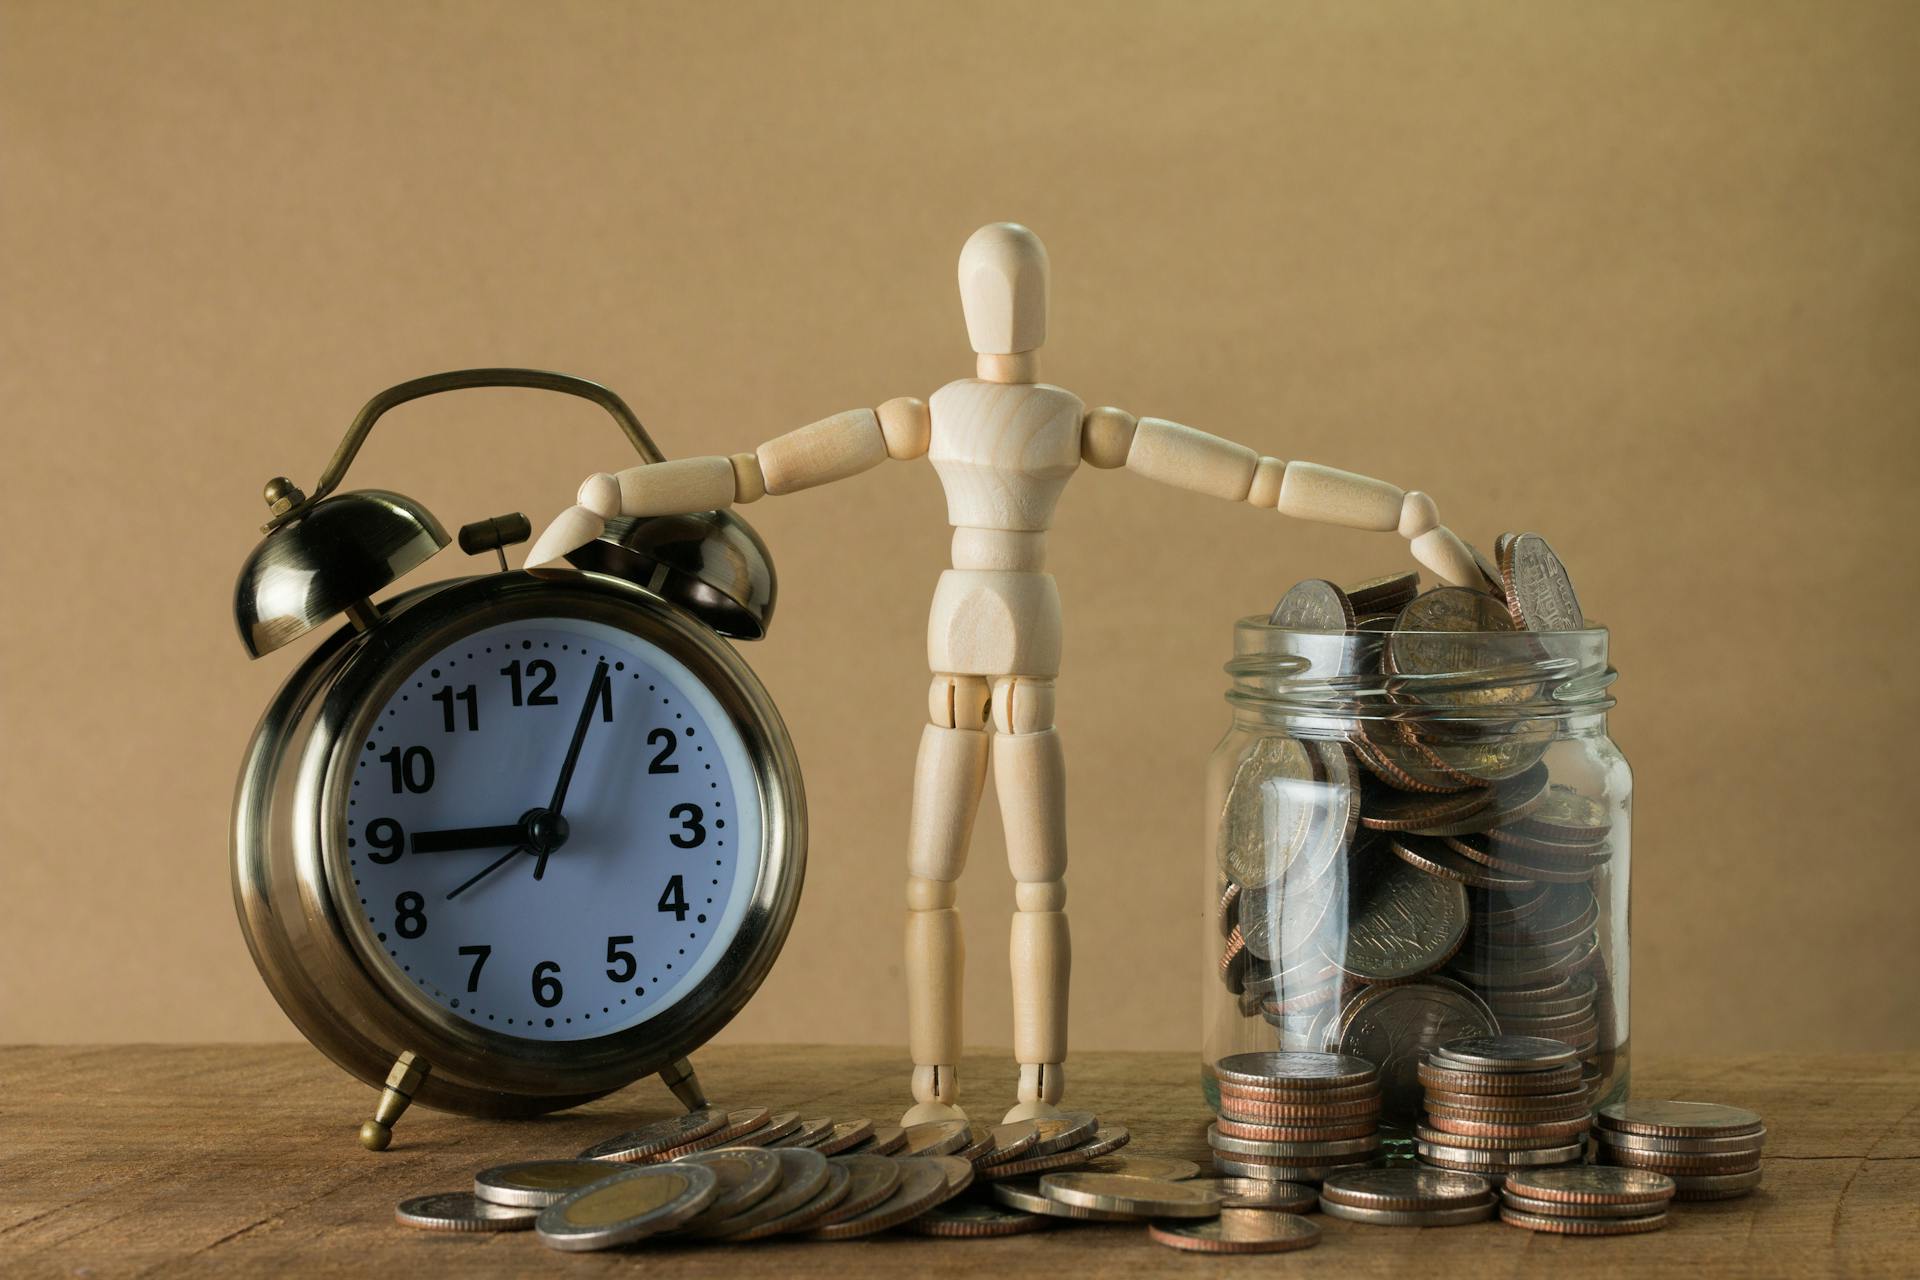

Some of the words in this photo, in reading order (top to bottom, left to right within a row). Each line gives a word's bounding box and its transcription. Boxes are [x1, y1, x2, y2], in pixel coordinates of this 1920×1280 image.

[500, 659, 559, 707] 12
[601, 676, 614, 723] 1
[432, 684, 479, 732] 11
[380, 745, 435, 794] 10
[646, 728, 680, 774] 2
[365, 817, 405, 864] 9
[669, 803, 706, 849] 3
[394, 891, 428, 939] 8
[657, 875, 690, 922] 4
[458, 945, 492, 993] 7
[606, 935, 637, 983] 5
[531, 961, 564, 1009] 6
